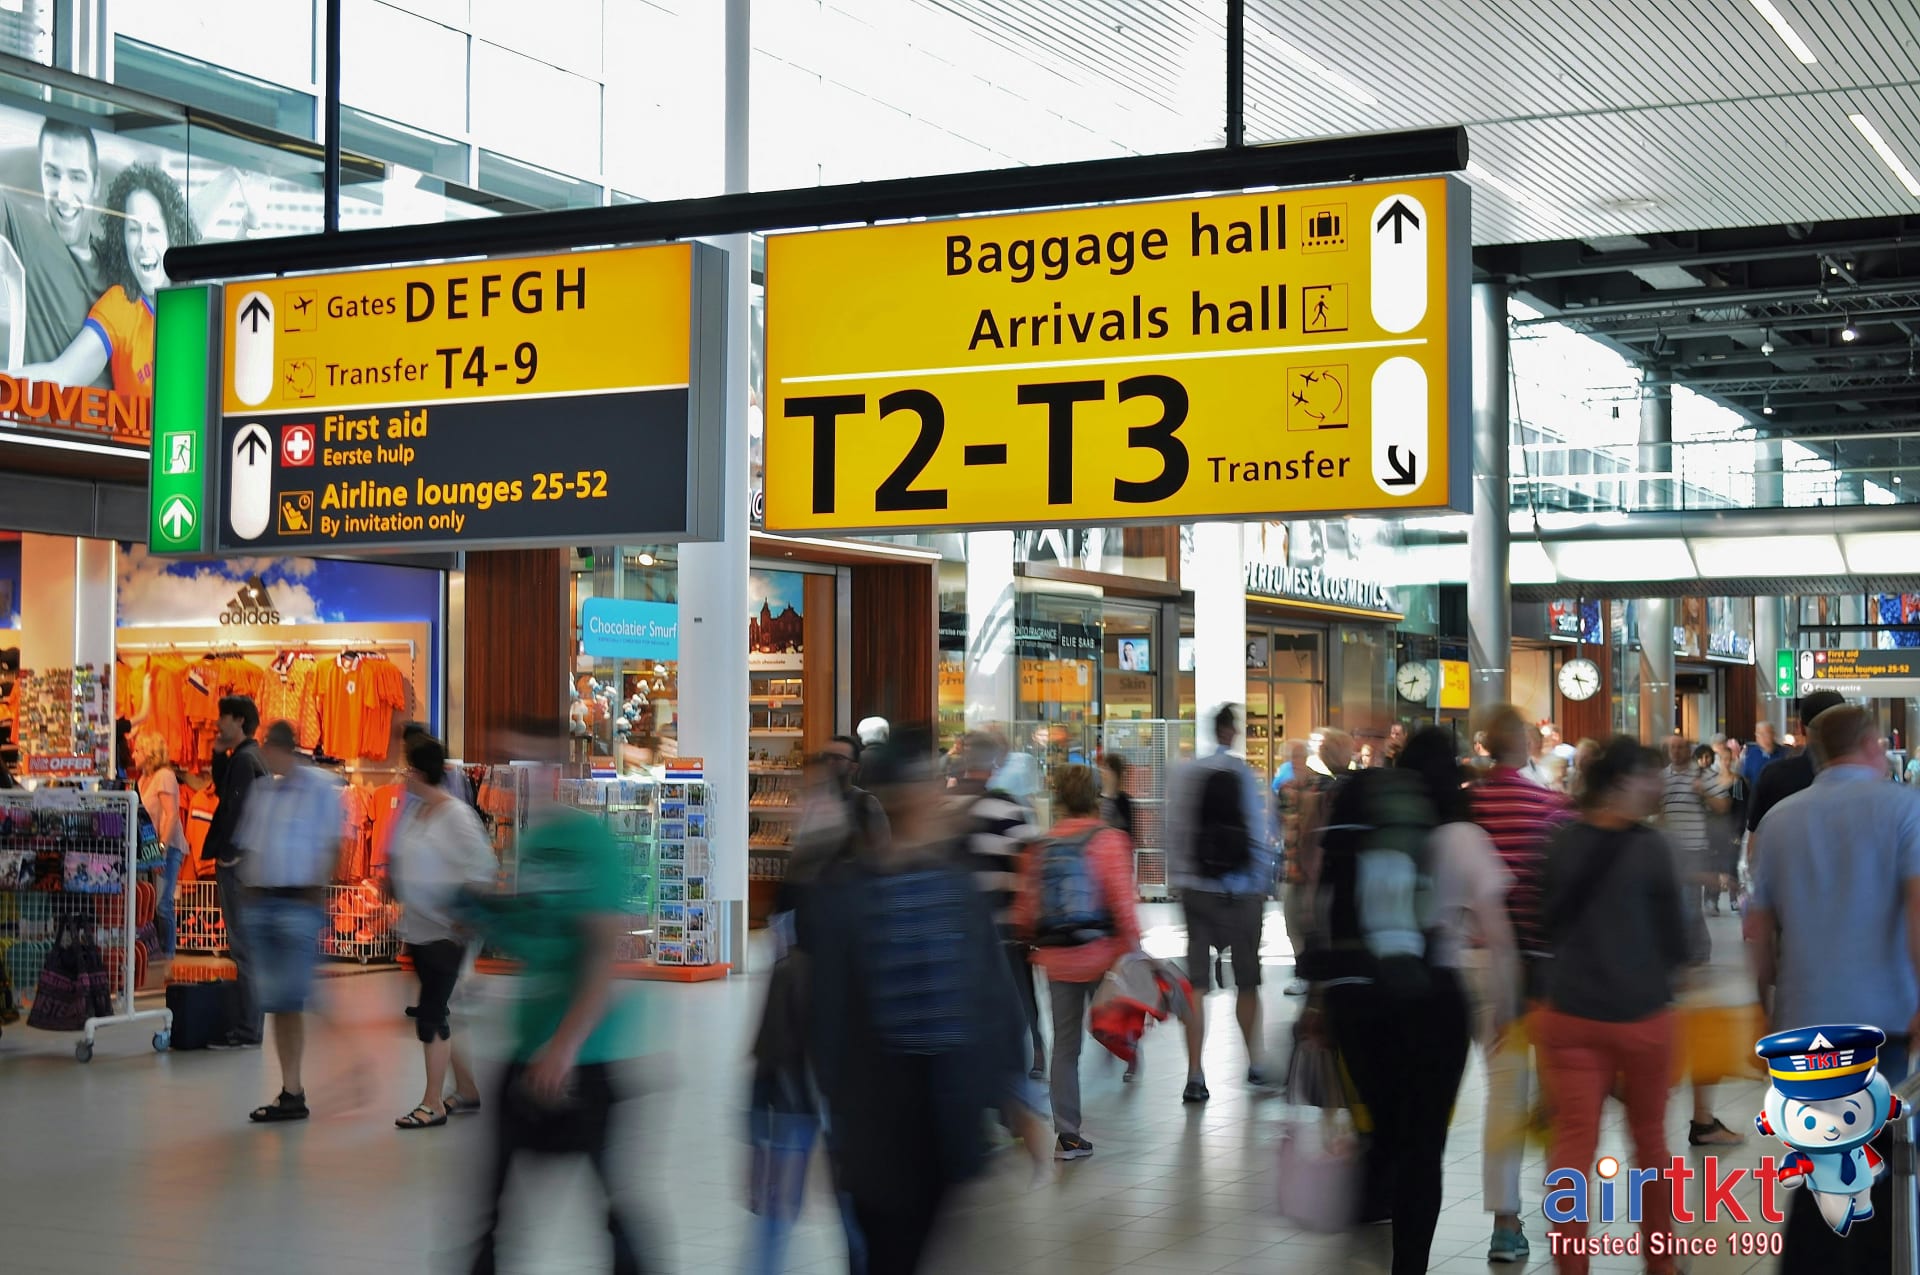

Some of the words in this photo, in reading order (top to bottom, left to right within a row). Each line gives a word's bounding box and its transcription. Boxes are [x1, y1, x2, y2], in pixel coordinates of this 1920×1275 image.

[946, 229, 1168, 283] Baggage
[1191, 204, 1286, 257] hall
[327, 296, 396, 319] Gates
[968, 295, 1168, 351] Arrivals
[1192, 284, 1287, 336] hall
[326, 358, 428, 386] Transfer
[436, 341, 538, 389] T4-9
[323, 414, 380, 443] First
[386, 408, 428, 438] aid
[323, 447, 372, 467] Eerste
[377, 443, 415, 467] hulp
[1207, 450, 1350, 484] Transfer
[320, 480, 408, 510] Airline
[416, 477, 523, 510] lounges
[531, 470, 608, 501] 25-52
[320, 515, 341, 538] By
[344, 511, 424, 534] invitation
[428, 510, 465, 533] only
[1244, 561, 1309, 596] PERFUMES
[1310, 565, 1321, 598] &
[1322, 575, 1387, 607] COSMETICS
[219, 607, 280, 625] adidas
[589, 616, 646, 637] Chocolatier
[649, 620, 677, 640] Smurf
[1029, 626, 1057, 641] FRAGRANCE
[1061, 636, 1077, 649] ELIE
[1078, 638, 1095, 650] SAAB
[1828, 665, 1854, 673] Airline
[1855, 665, 1887, 675] lounges
[1120, 677, 1146, 691] Skin
[1837, 684, 1861, 692] centre
[50, 757, 92, 771] OFFER
